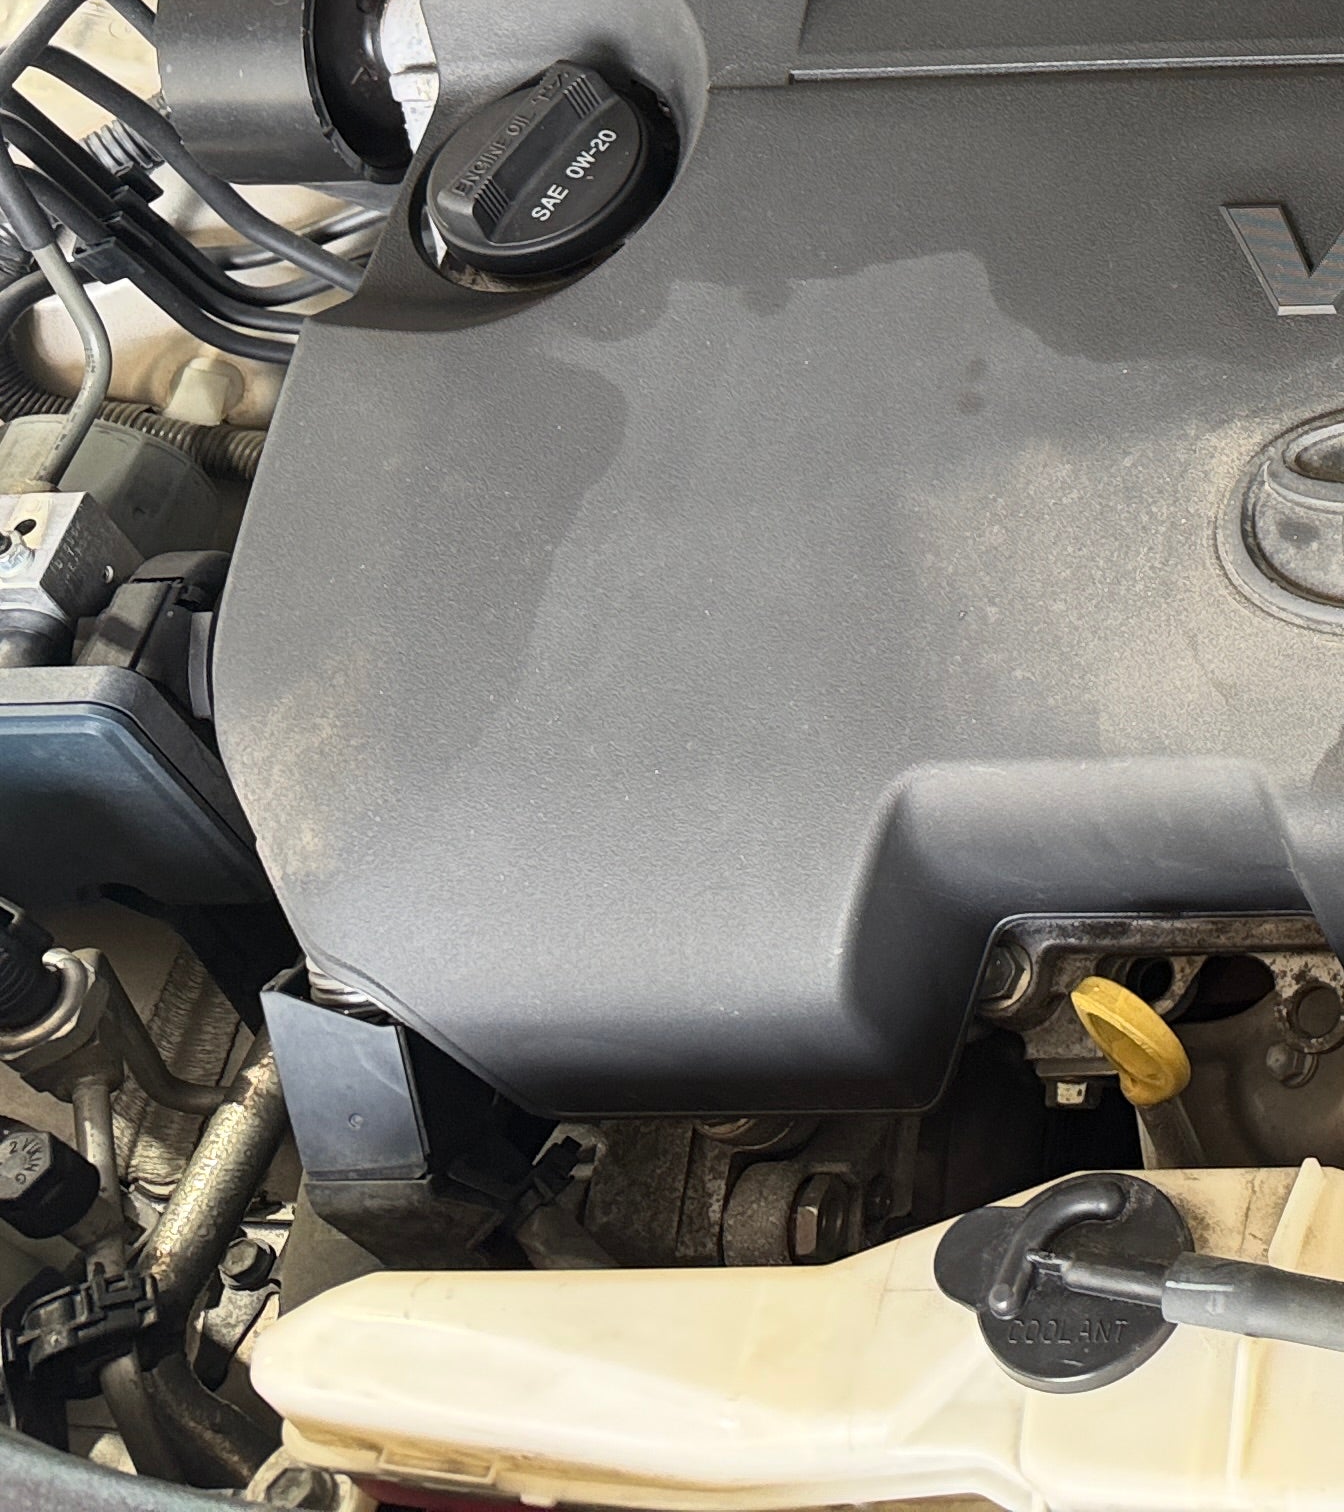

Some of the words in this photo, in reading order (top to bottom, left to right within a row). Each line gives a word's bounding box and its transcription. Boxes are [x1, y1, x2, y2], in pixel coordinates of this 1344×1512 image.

[531, 184, 570, 222] SAE
[565, 129, 617, 179] 0W-20
[1008, 1319, 1129, 1345] COOLANT
